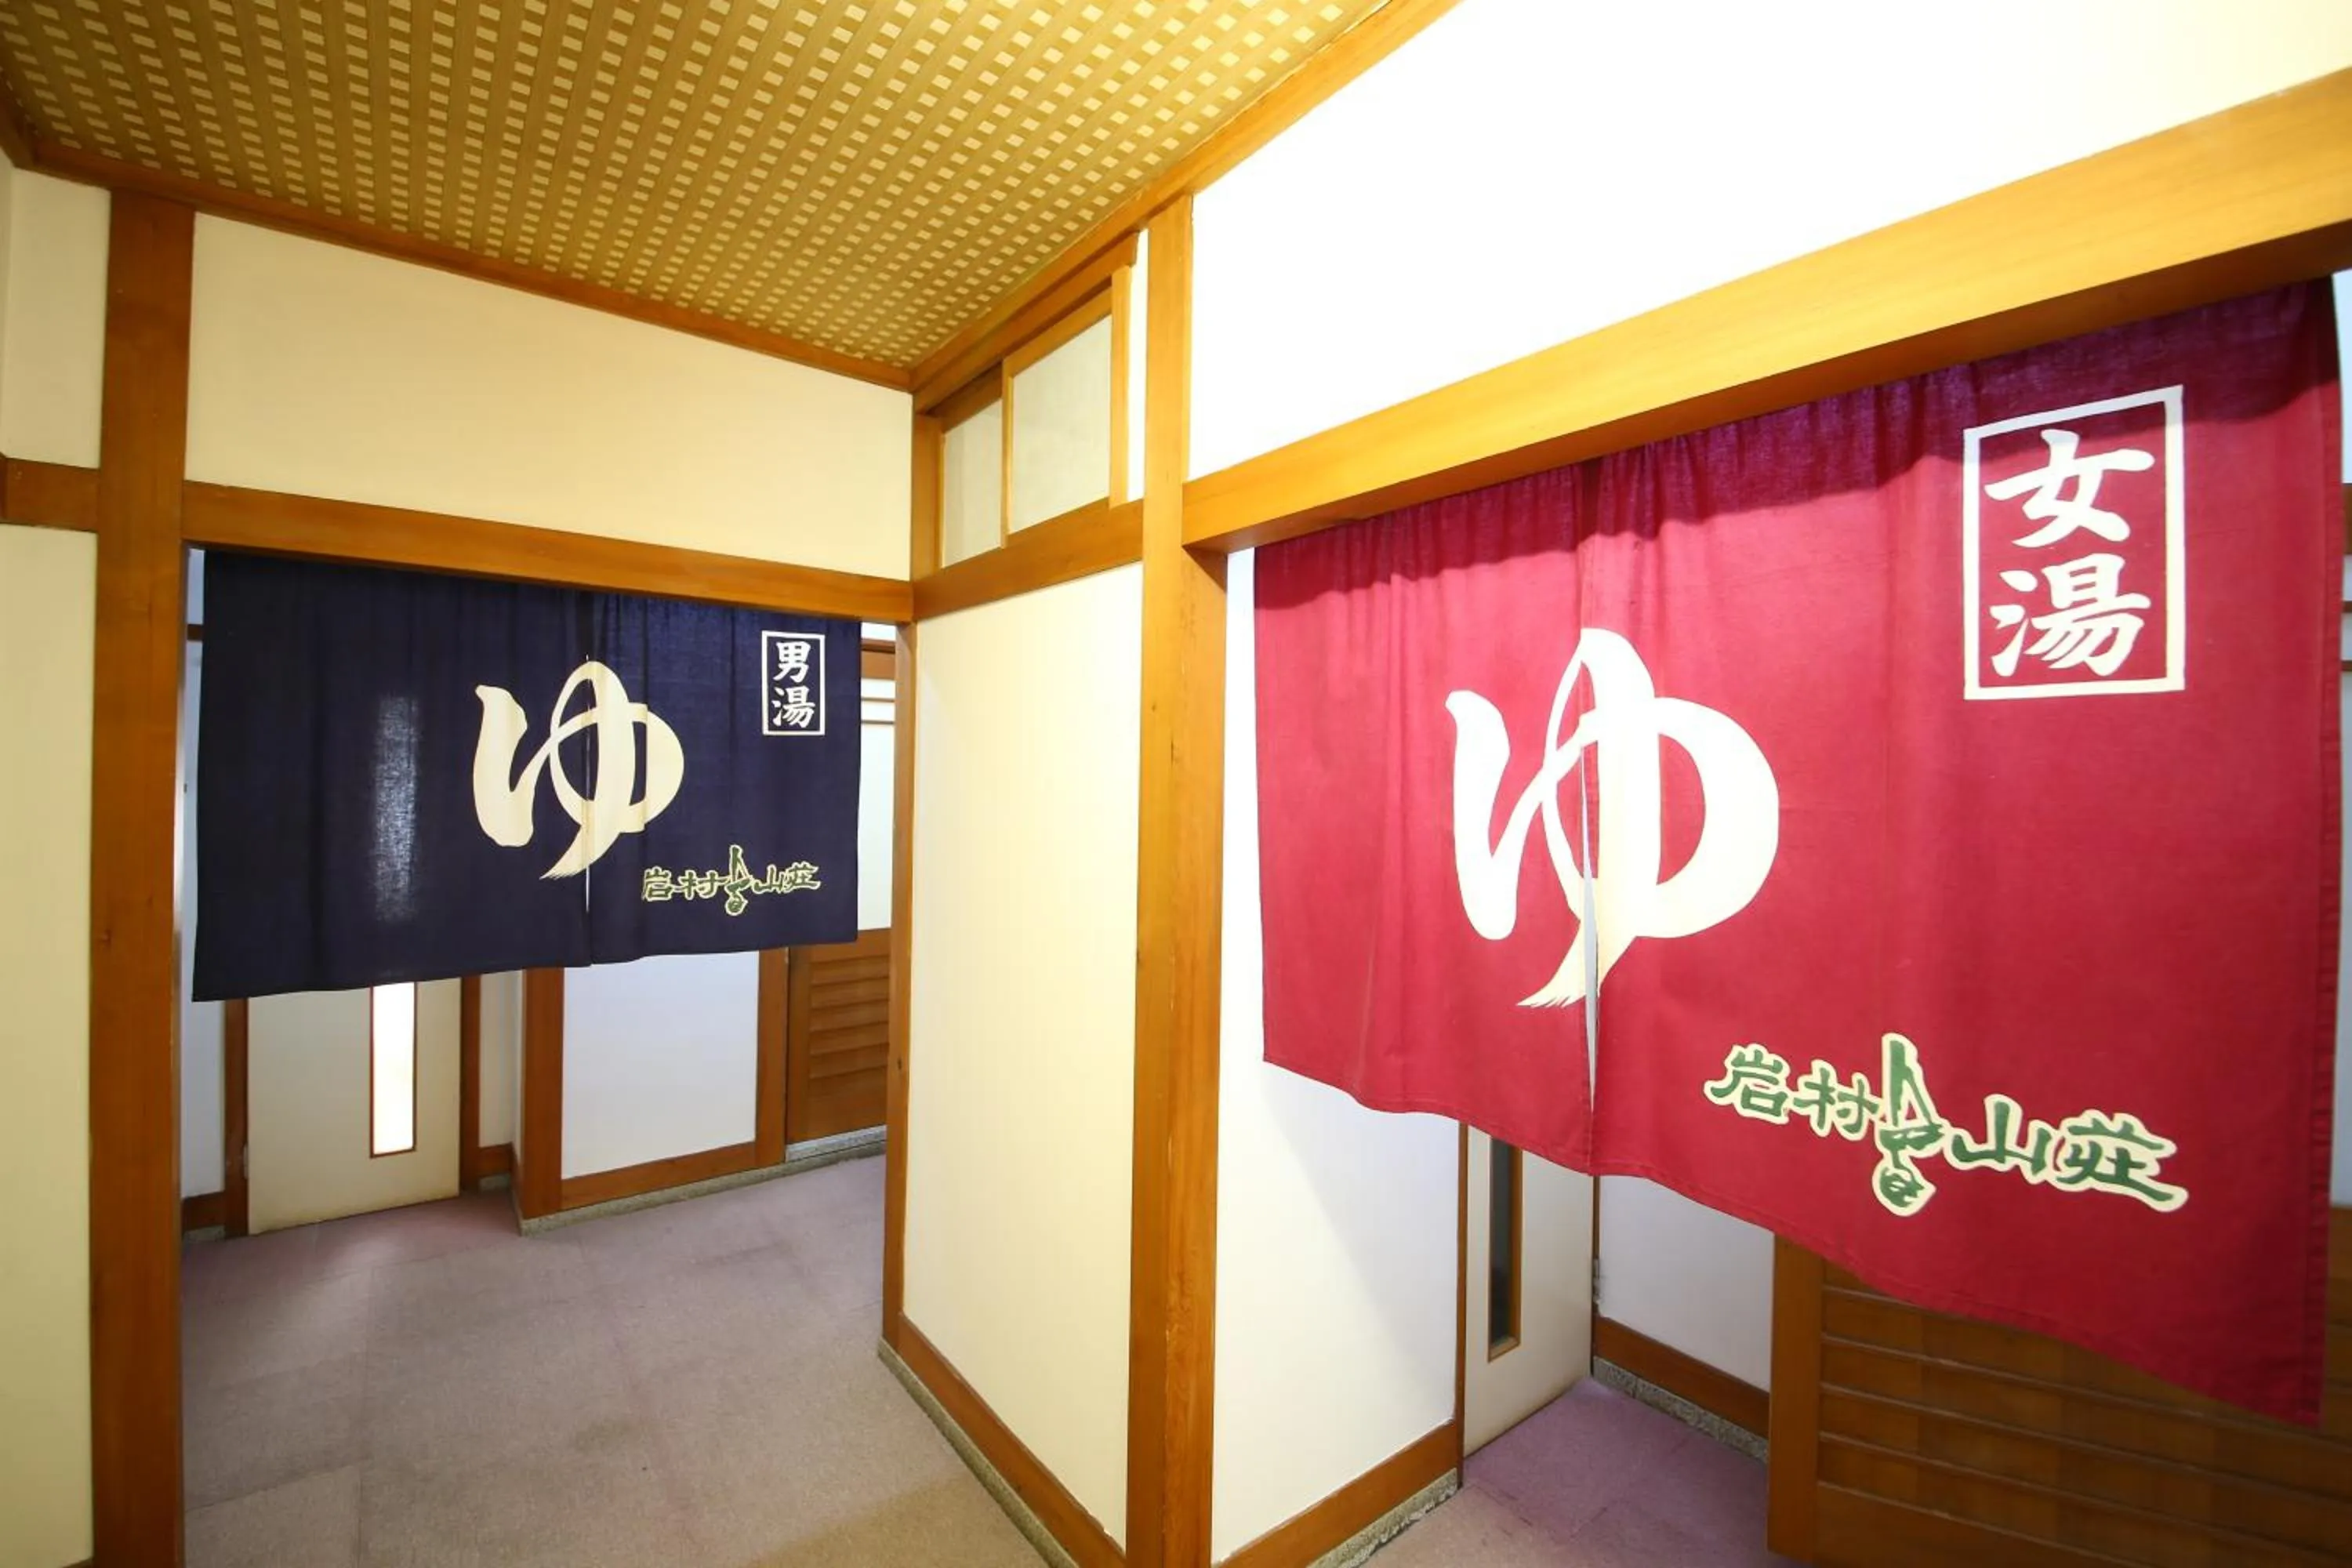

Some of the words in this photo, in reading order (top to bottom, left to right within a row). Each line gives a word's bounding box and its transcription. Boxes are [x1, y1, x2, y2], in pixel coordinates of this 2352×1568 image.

[1984, 428, 2156, 677] 女湯
[474, 661, 684, 880] ゆ
[771, 641, 816, 728] 男湯
[1445, 627, 1780, 1007] ゆ
